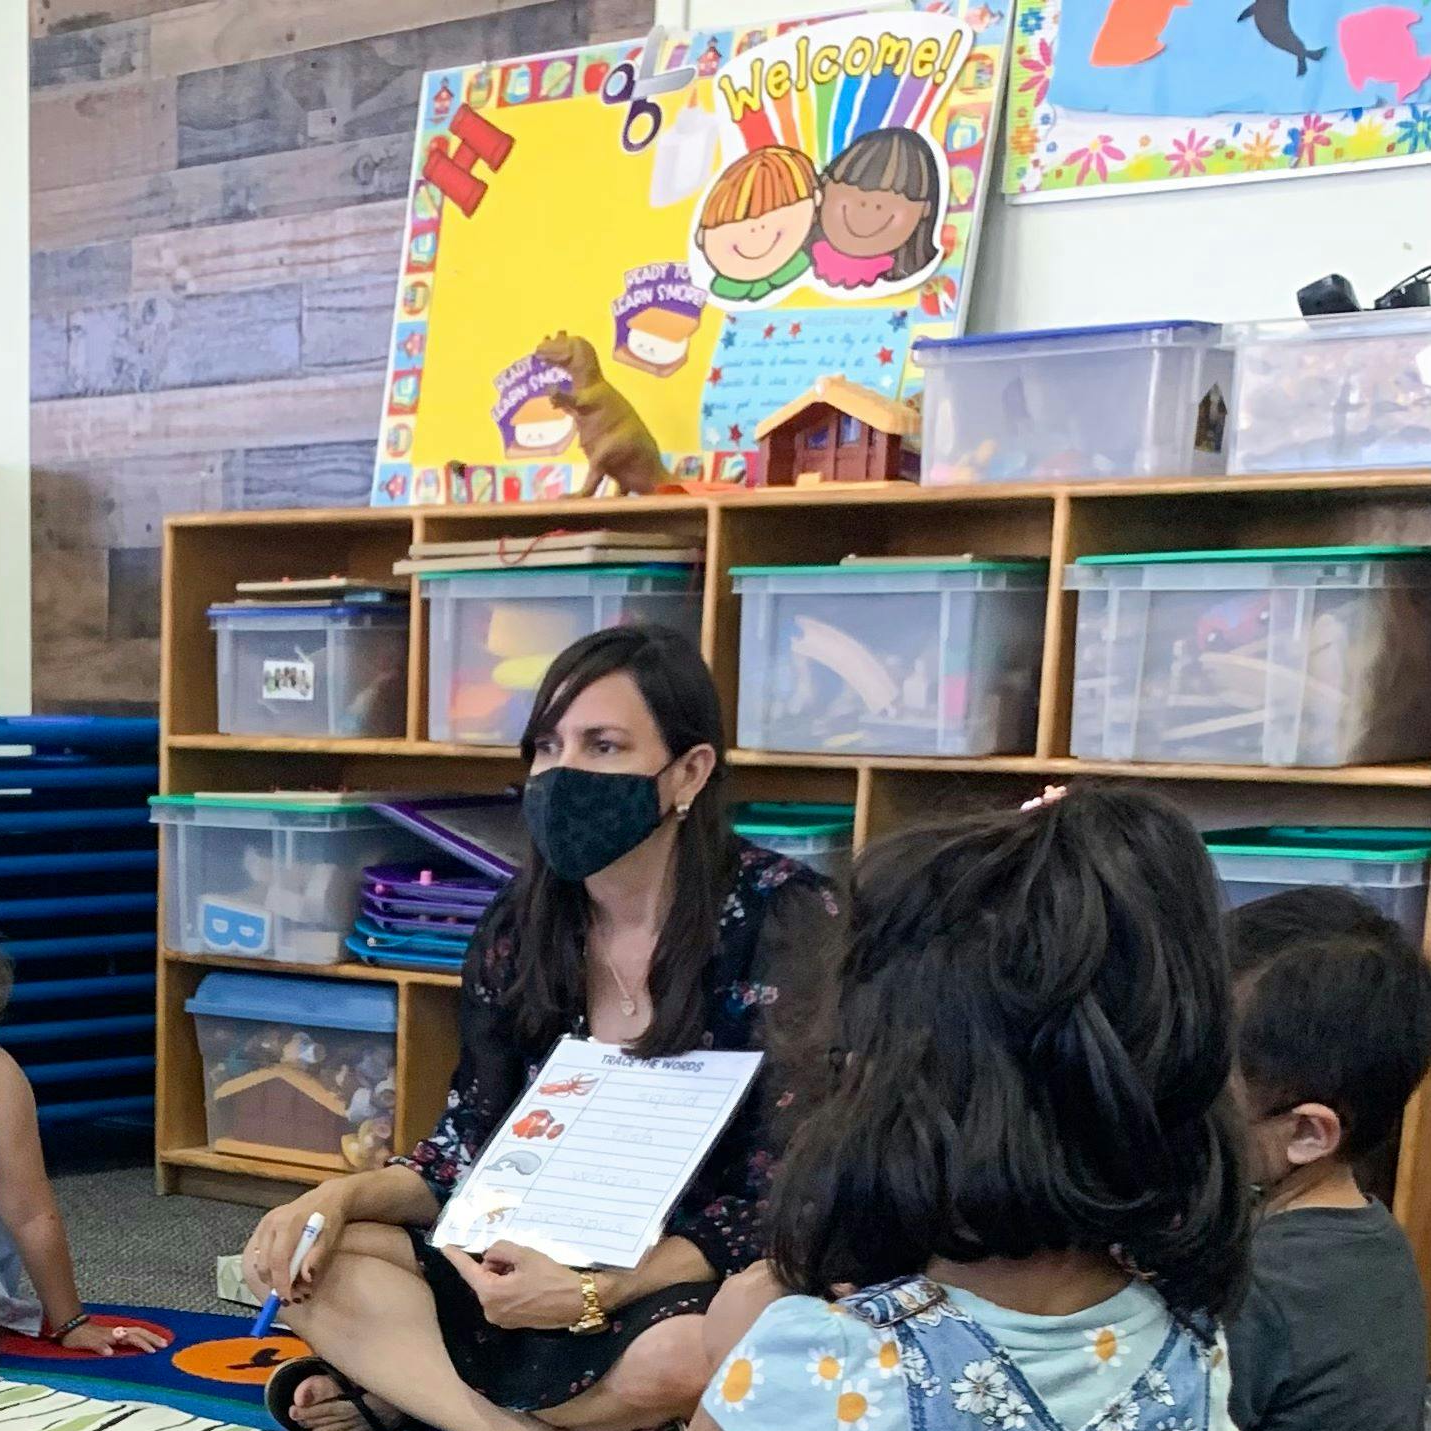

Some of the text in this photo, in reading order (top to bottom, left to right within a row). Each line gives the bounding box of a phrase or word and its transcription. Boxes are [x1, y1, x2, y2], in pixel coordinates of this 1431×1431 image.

[718, 30, 964, 123] Welcome!
[600, 1054, 635, 1067] TRACE
[661, 1060, 705, 1073] WORDS
